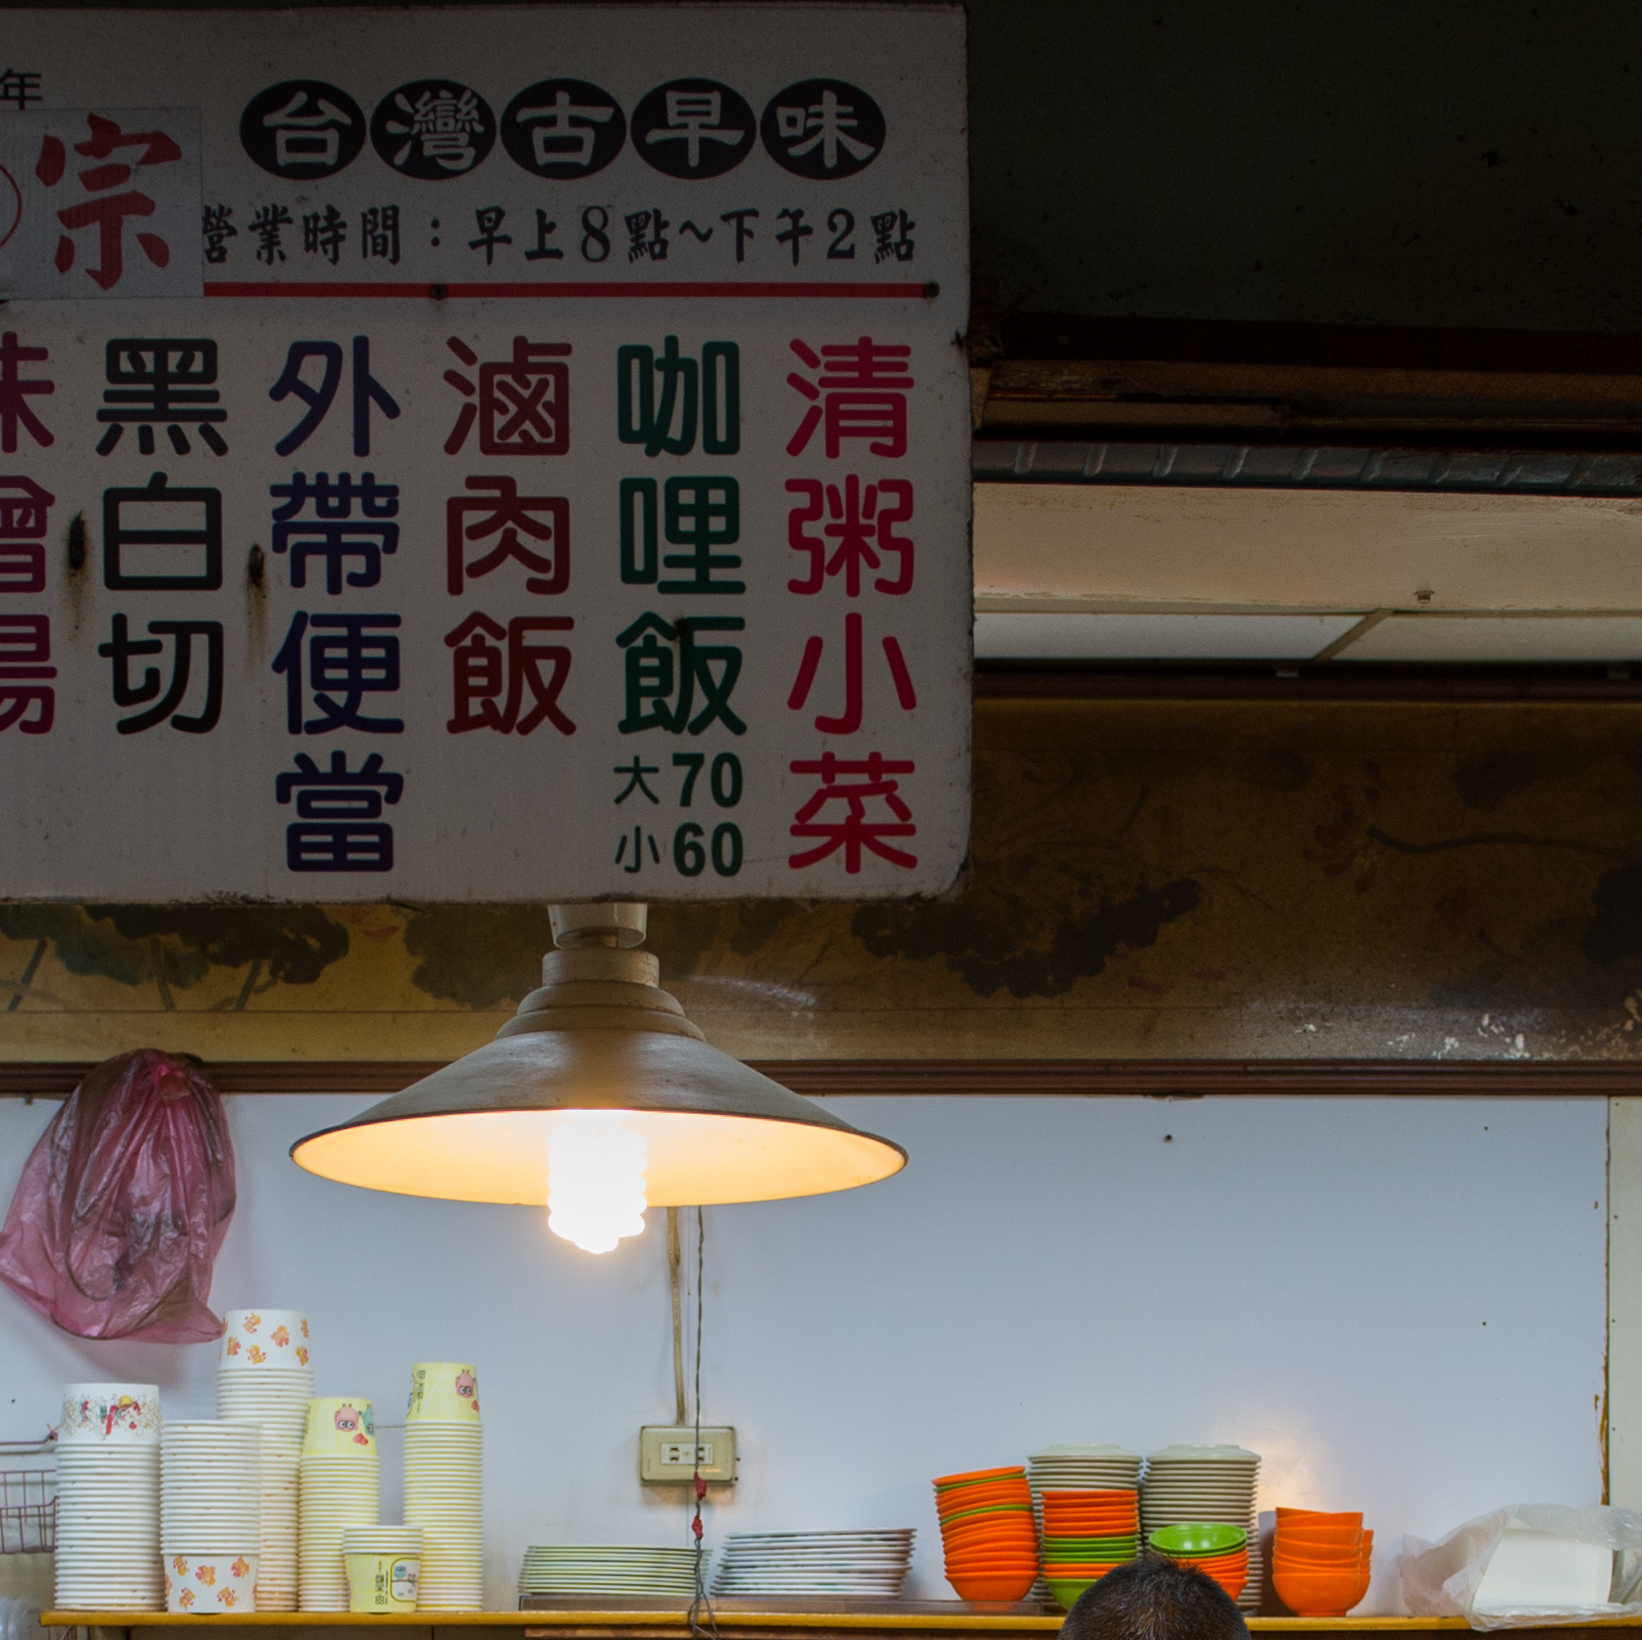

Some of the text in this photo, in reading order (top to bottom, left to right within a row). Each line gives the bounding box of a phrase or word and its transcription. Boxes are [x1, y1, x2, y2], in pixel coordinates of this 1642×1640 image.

[261, 87, 878, 172] 台灣古早味
[95, 336, 229, 736] 黑白切
[268, 335, 403, 876] 外帶便當
[441, 335, 577, 737] 滷肉飯
[614, 335, 748, 738] 咖哩飯
[783, 335, 919, 876] 清粥小菜
